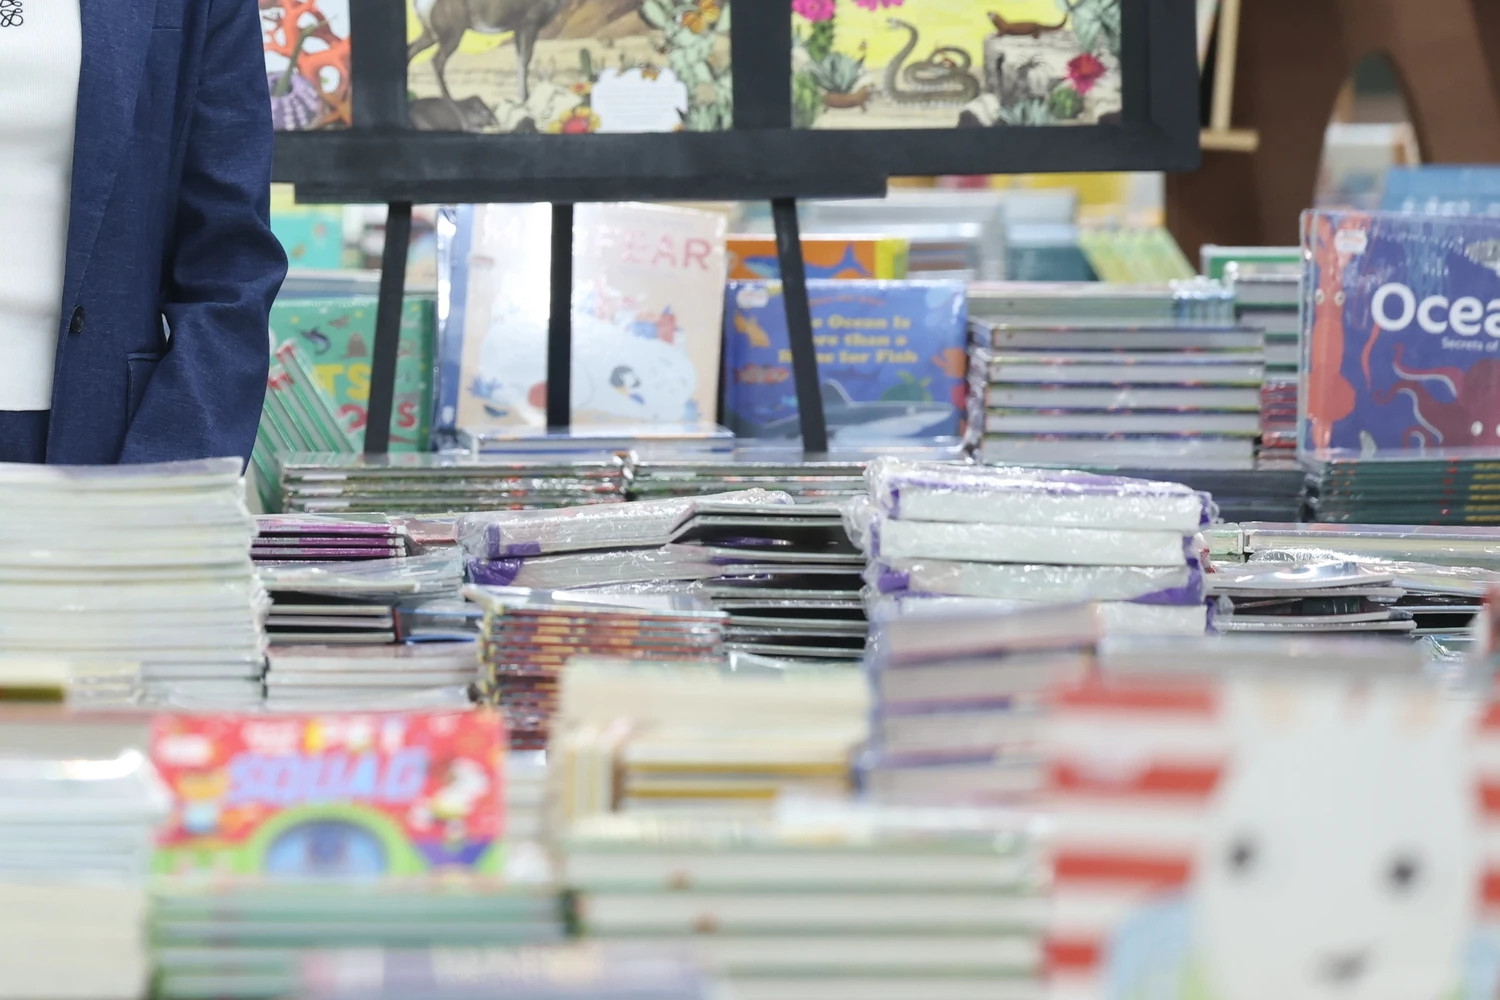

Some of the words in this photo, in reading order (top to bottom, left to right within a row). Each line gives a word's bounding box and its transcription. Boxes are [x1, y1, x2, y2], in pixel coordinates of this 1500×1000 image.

[827, 314, 888, 330] Ocean
[843, 332, 891, 347] than
[1441, 336, 1484, 351] Secrets
[875, 349, 919, 364] Fish
[229, 746, 431, 805] SQUAD
